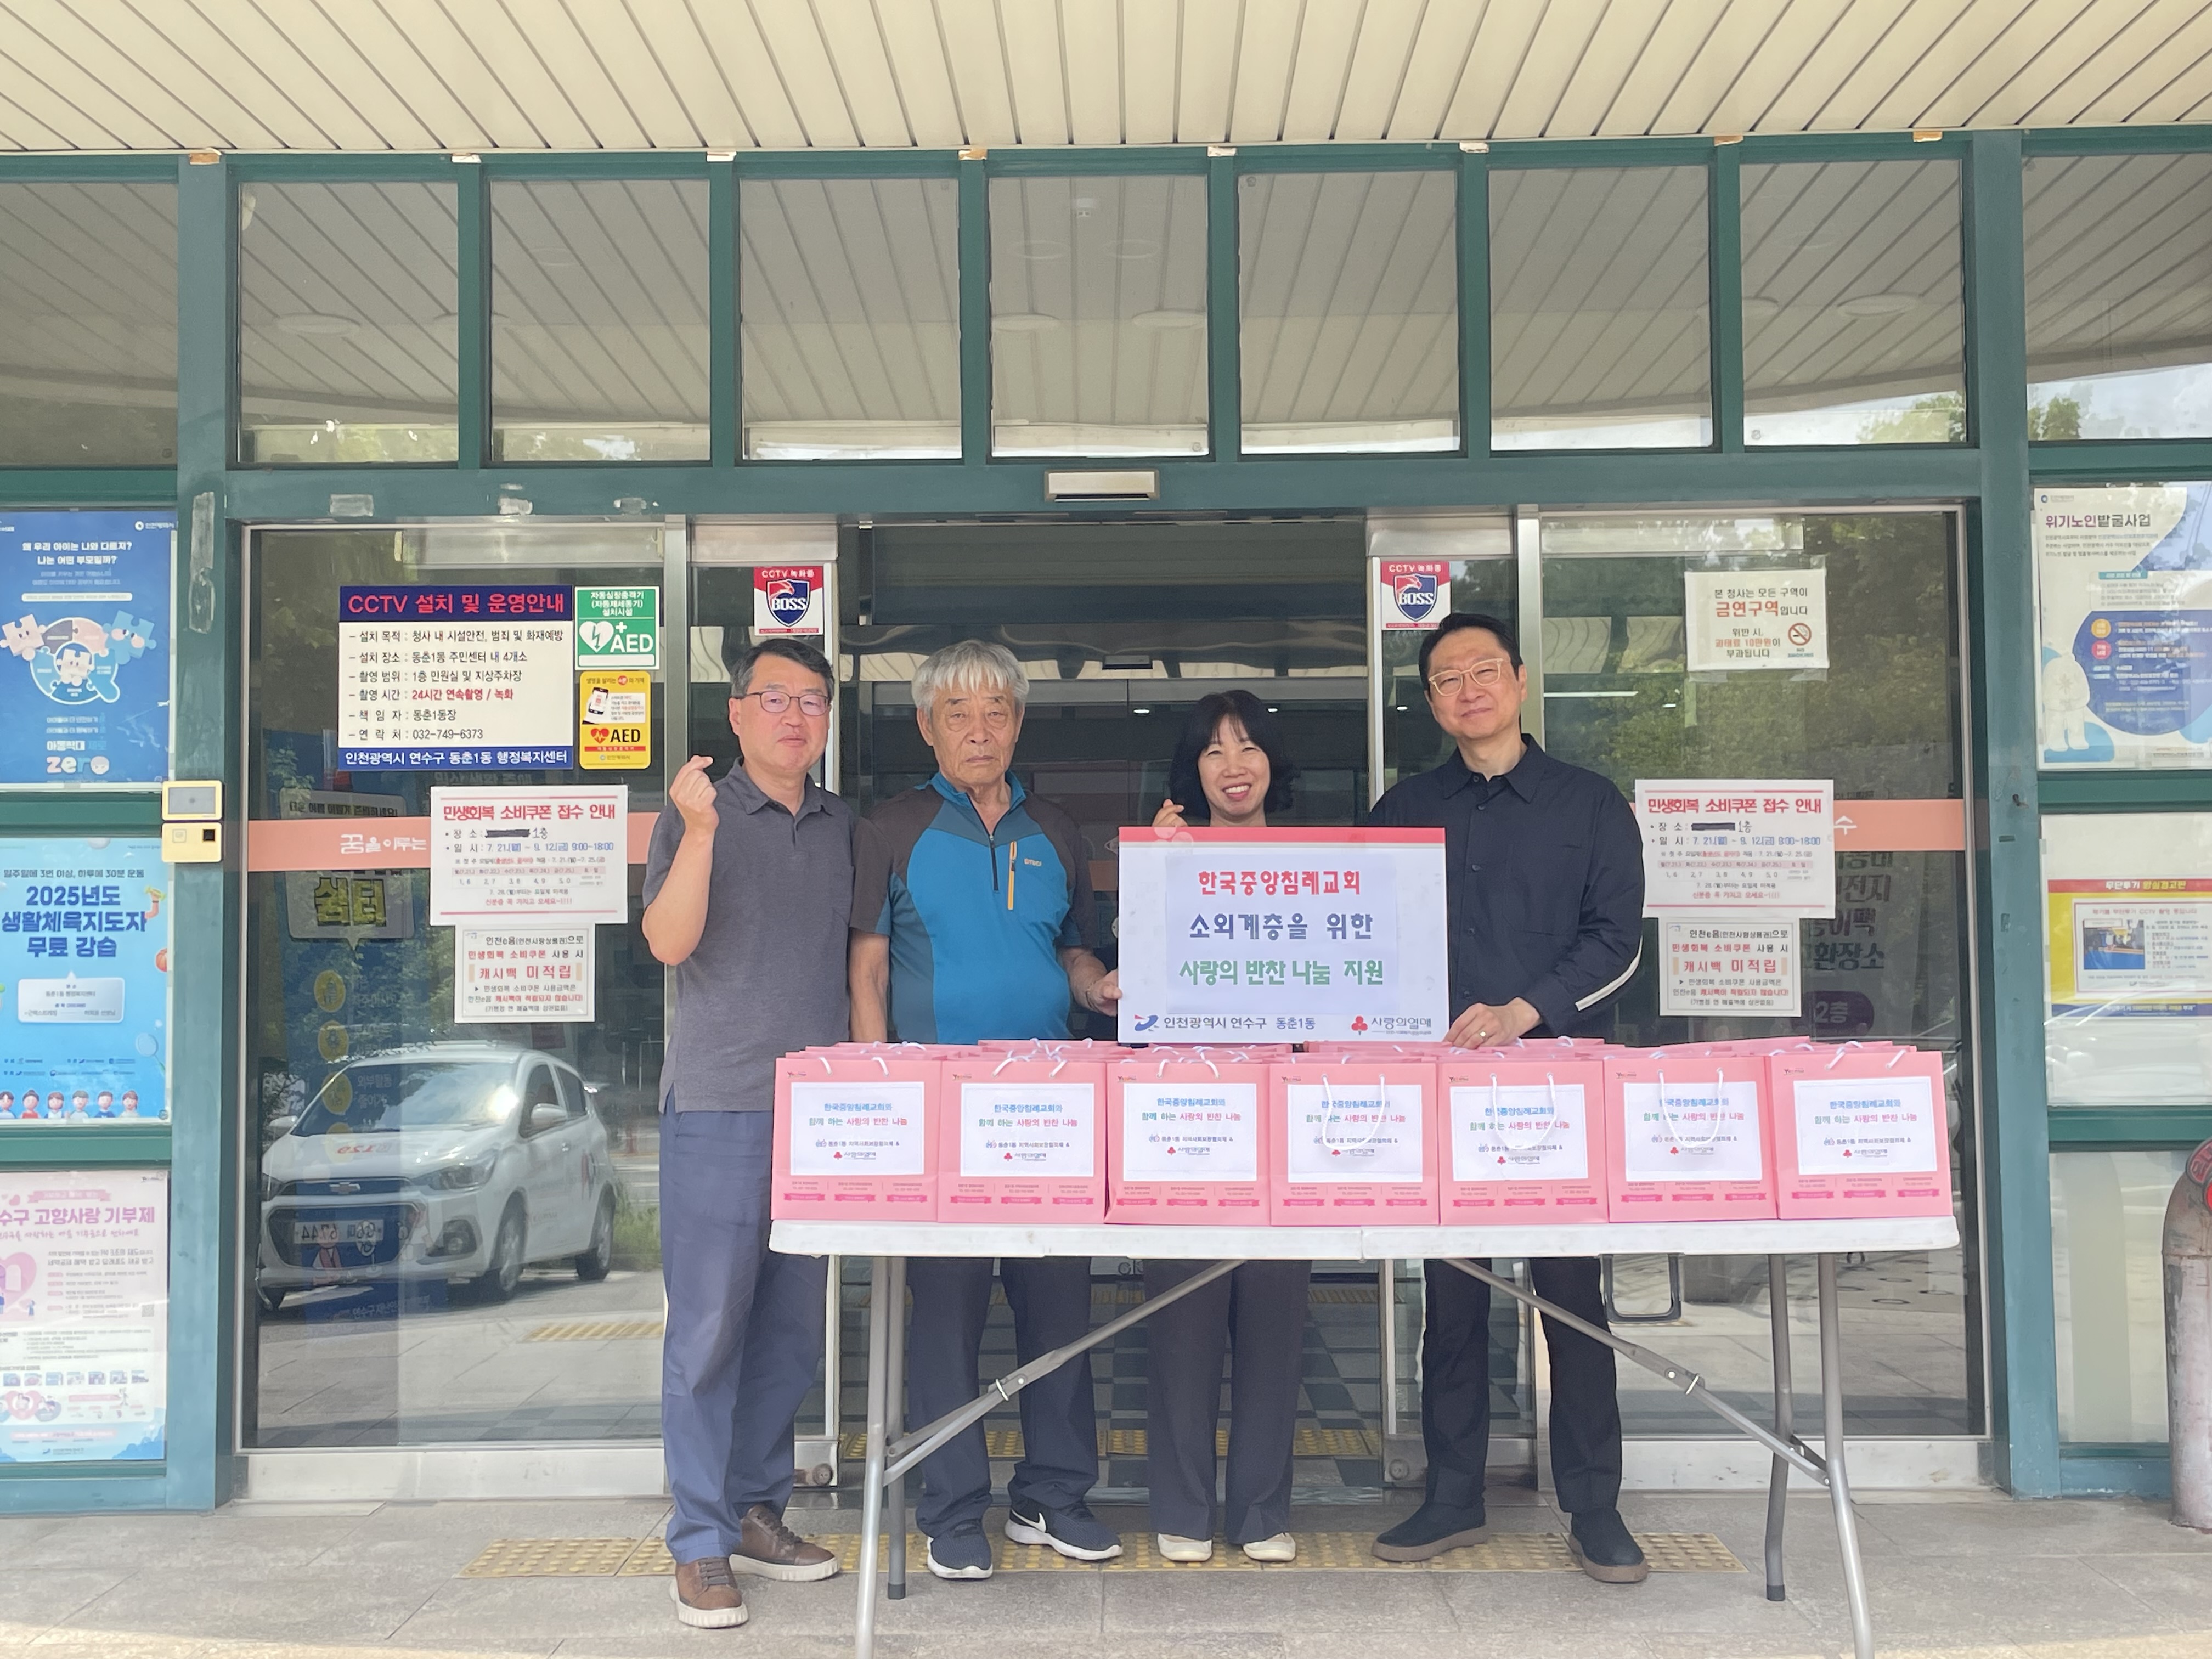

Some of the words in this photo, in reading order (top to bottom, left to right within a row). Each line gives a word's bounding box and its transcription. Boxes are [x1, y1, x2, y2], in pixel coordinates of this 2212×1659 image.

[2045, 514, 2151, 528] 위기노인발굴사업
[761, 569, 788, 578] CCTV
[1389, 564, 1415, 572] CCTV
[590, 590, 644, 600] 자동심장충격기
[1399, 592, 1435, 605] BOSS
[1714, 589, 1723, 599] 본
[1727, 588, 1754, 599] 청사는
[1758, 588, 1776, 597] 모든
[1780, 587, 1808, 597] 구역이
[348, 594, 408, 613] CCTV
[415, 593, 453, 613] 설치
[461, 592, 480, 613] 및
[487, 592, 564, 613] 운영안내
[591, 600, 644, 609] (자동제세동기)
[771, 597, 806, 611] BOSS
[602, 608, 633, 617] 설치시설
[359, 630, 378, 642] 설치
[412, 630, 431, 642] 청사
[435, 630, 444, 642] 내
[491, 630, 510, 641] 범죄
[514, 630, 522, 641] 및
[526, 629, 563, 641] 화재예방
[1732, 628, 1750, 637] 위반
[610, 634, 654, 653] AED
[1715, 639, 1741, 648] 과태료
[1745, 637, 1781, 647] 10만원이
[359, 652, 378, 663] 설치
[411, 651, 445, 664] 동춘1동
[449, 651, 487, 663] 주민센터
[490, 651, 499, 662] 내
[503, 651, 527, 662] 4개소
[1726, 648, 1770, 658] 부과됩니다
[359, 671, 378, 683] 촬영
[413, 670, 427, 682] 1층
[431, 670, 458, 682] 민원실
[462, 670, 471, 682] 및
[475, 670, 522, 682] 지상주차장
[359, 689, 378, 701] 촬영
[411, 689, 442, 701] 24시간
[446, 689, 483, 701] 연속촬영
[494, 688, 514, 701] 녹화
[413, 709, 456, 721] 동춘1동장
[413, 729, 483, 740] 032-749-6373
[610, 729, 641, 743] AED
[345, 752, 405, 765] 인천광역시
[409, 752, 445, 765] 연수구
[449, 751, 493, 765] 동춘1동
[496, 750, 567, 764] 행정복지센터
[443, 805, 495, 820] 민생회복
[500, 805, 552, 820] 소비쿠폰
[557, 804, 584, 820] 접수
[589, 804, 616, 819] 안내
[1647, 798, 1700, 814] 민생회복
[1705, 798, 1757, 813] 소비쿠폰
[1763, 798, 1790, 813] 접수
[1795, 798, 1821, 814] 안내
[3, 869, 38, 878] 일주일에
[40, 870, 54, 878] 3번
[78, 869, 104, 878] 하루에
[106, 869, 125, 878] 30분
[127, 869, 144, 878] 운동
[1198, 870, 1362, 896] 한국중앙침례교회
[26, 885, 121, 906] 2025년도
[1, 911, 147, 933] 생활체육지도자
[1189, 913, 1308, 941] 소외계층을
[1326, 913, 1373, 940] 위한
[27, 936, 69, 958] 무료
[76, 936, 117, 958] 강습
[1672, 943, 1709, 953] 민생회복
[1714, 943, 1751, 952] 소비쿠폰
[1757, 943, 1774, 953] 사용
[1780, 943, 1788, 953] 시
[468, 950, 504, 960] 민생회복
[510, 950, 546, 960] 소비쿠폰
[552, 949, 569, 959] 사용
[575, 949, 584, 958] 시
[479, 967, 517, 980] 캐시백
[526, 964, 571, 979] 미적립
[1179, 960, 1238, 986] 사랑의
[1245, 960, 1286, 986] 반찬
[1292, 960, 1330, 986] 나눔
[1343, 960, 1384, 986] 지원
[1684, 960, 1722, 973] 캐시백
[1731, 959, 1777, 974] 미적립
[1815, 1001, 1848, 1024] 2층
[1164, 1016, 1227, 1030] 인천광역시
[1231, 1017, 1267, 1030] 연수구
[1276, 1016, 1316, 1030] 동춘1동
[1371, 1016, 1432, 1029] 사랑의열매
[35, 1208, 100, 1224] 고향사랑
[105, 1206, 155, 1223] 기부제
